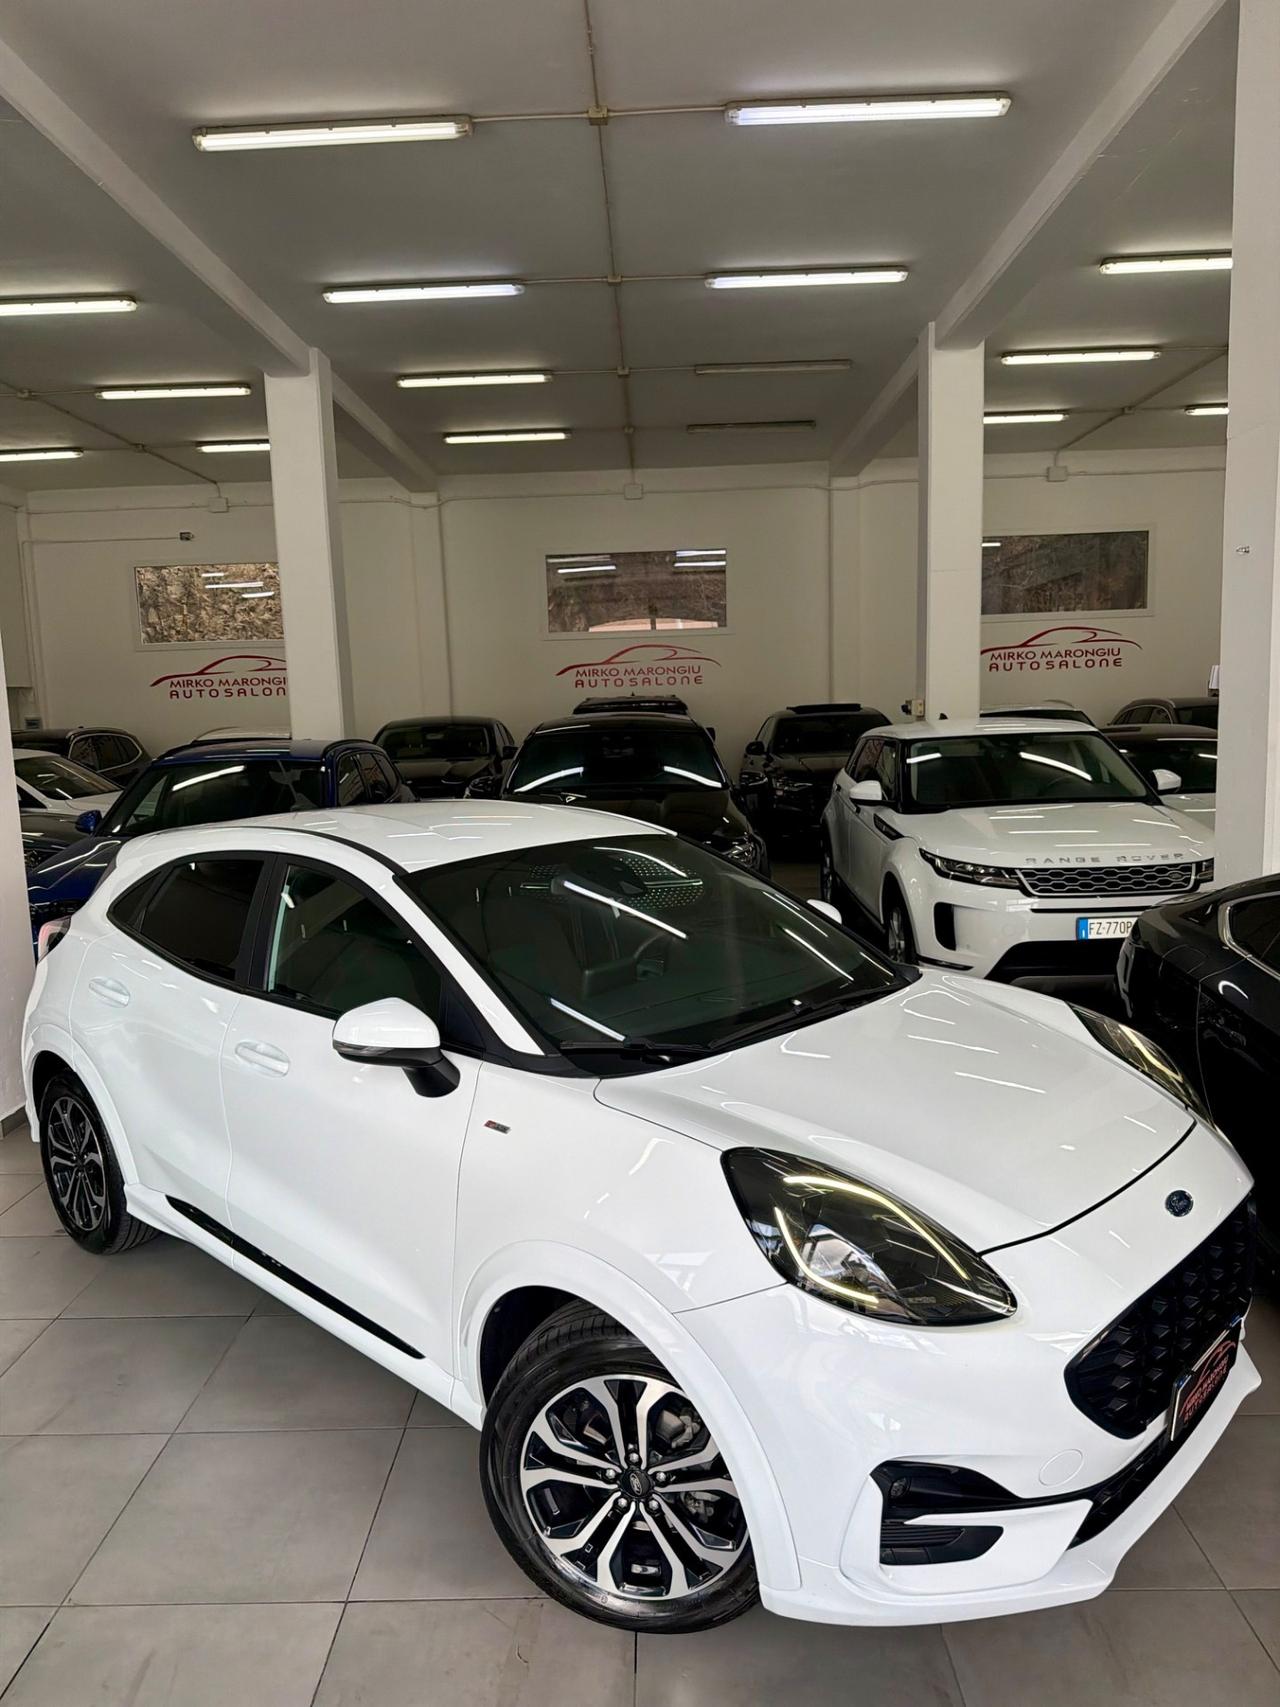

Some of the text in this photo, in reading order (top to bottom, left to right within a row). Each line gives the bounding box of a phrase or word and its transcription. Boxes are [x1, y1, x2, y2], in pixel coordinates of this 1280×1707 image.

[990, 647, 1121, 661] MIRKO MARONGIU
[989, 657, 1122, 672] AUTOSALONE
[575, 665, 701, 678] MIRKO MARONGIU
[169, 677, 287, 688] MIRKO MARONGI
[575, 675, 703, 688] AUTOSALONE
[169, 687, 287, 699] AUTOSALON
[1025, 852, 1184, 864] RANGE ROVER
